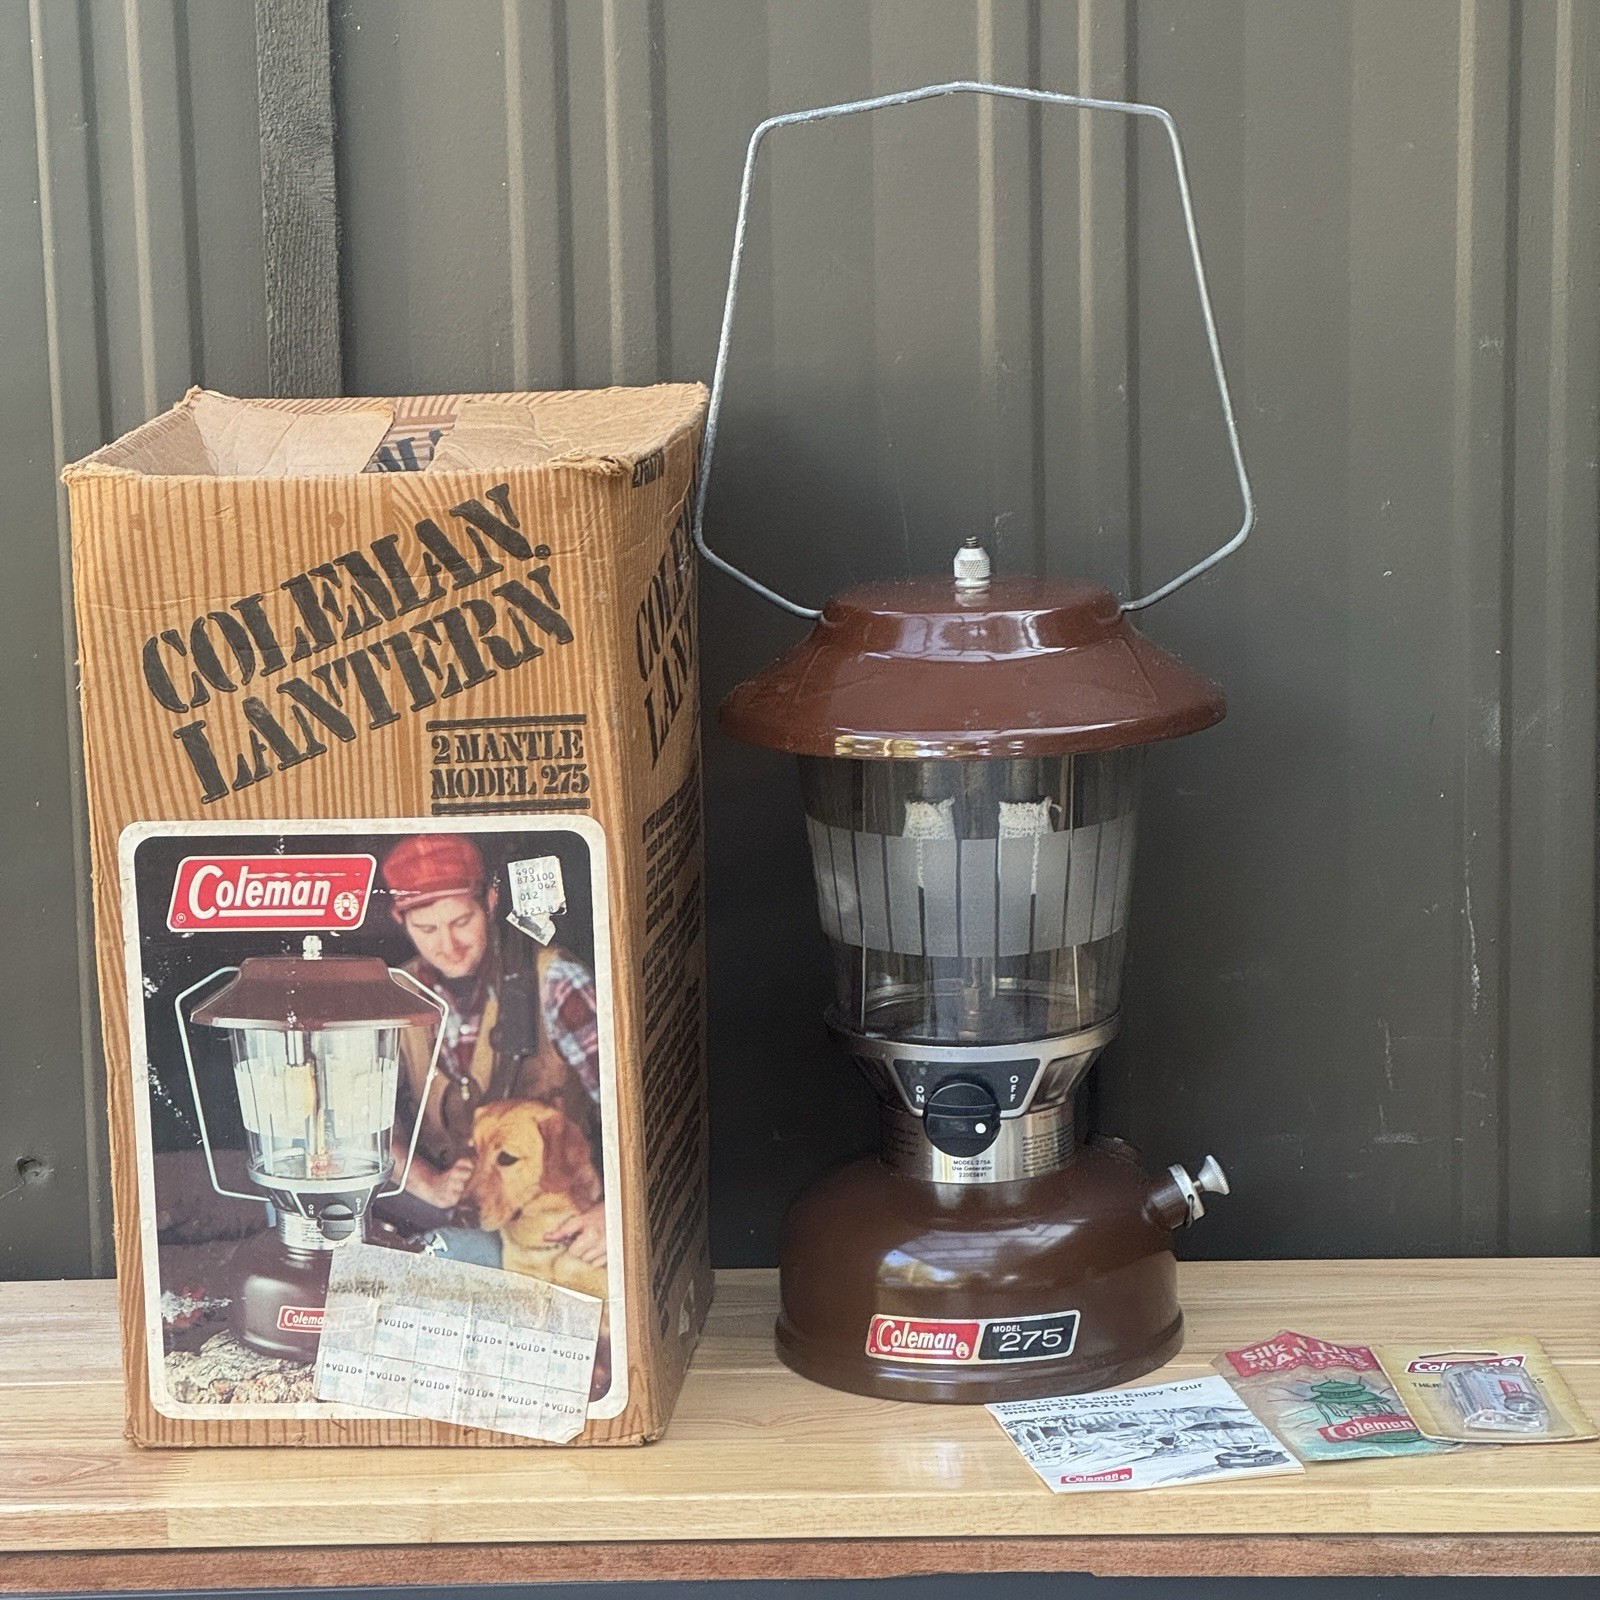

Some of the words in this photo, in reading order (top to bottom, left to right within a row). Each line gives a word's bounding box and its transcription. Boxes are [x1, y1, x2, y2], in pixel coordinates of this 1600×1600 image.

[173, 565, 574, 804] LANTERN
[431, 734, 451, 764] 2
[454, 729, 584, 763] MANTLE
[430, 765, 537, 799] MODEL
[541, 763, 590, 794] 275
[188, 864, 331, 920] Coleman
[520, 891, 538, 901] 012
[915, 1085, 925, 1103] ON
[1009, 1075, 1019, 1102] OFF
[284, 1310, 324, 1326] Colema
[876, 1320, 957, 1352] Coleman
[992, 1325, 1022, 1334] MODEL
[998, 1327, 1065, 1352] 275
[1241, 1343, 1288, 1361] Silk
[1124, 1388, 1164, 1399] Enjoy
[1170, 1382, 1203, 1392] Your
[1327, 1419, 1413, 1439] Coleman
[1065, 1473, 1119, 1483] Coleman
